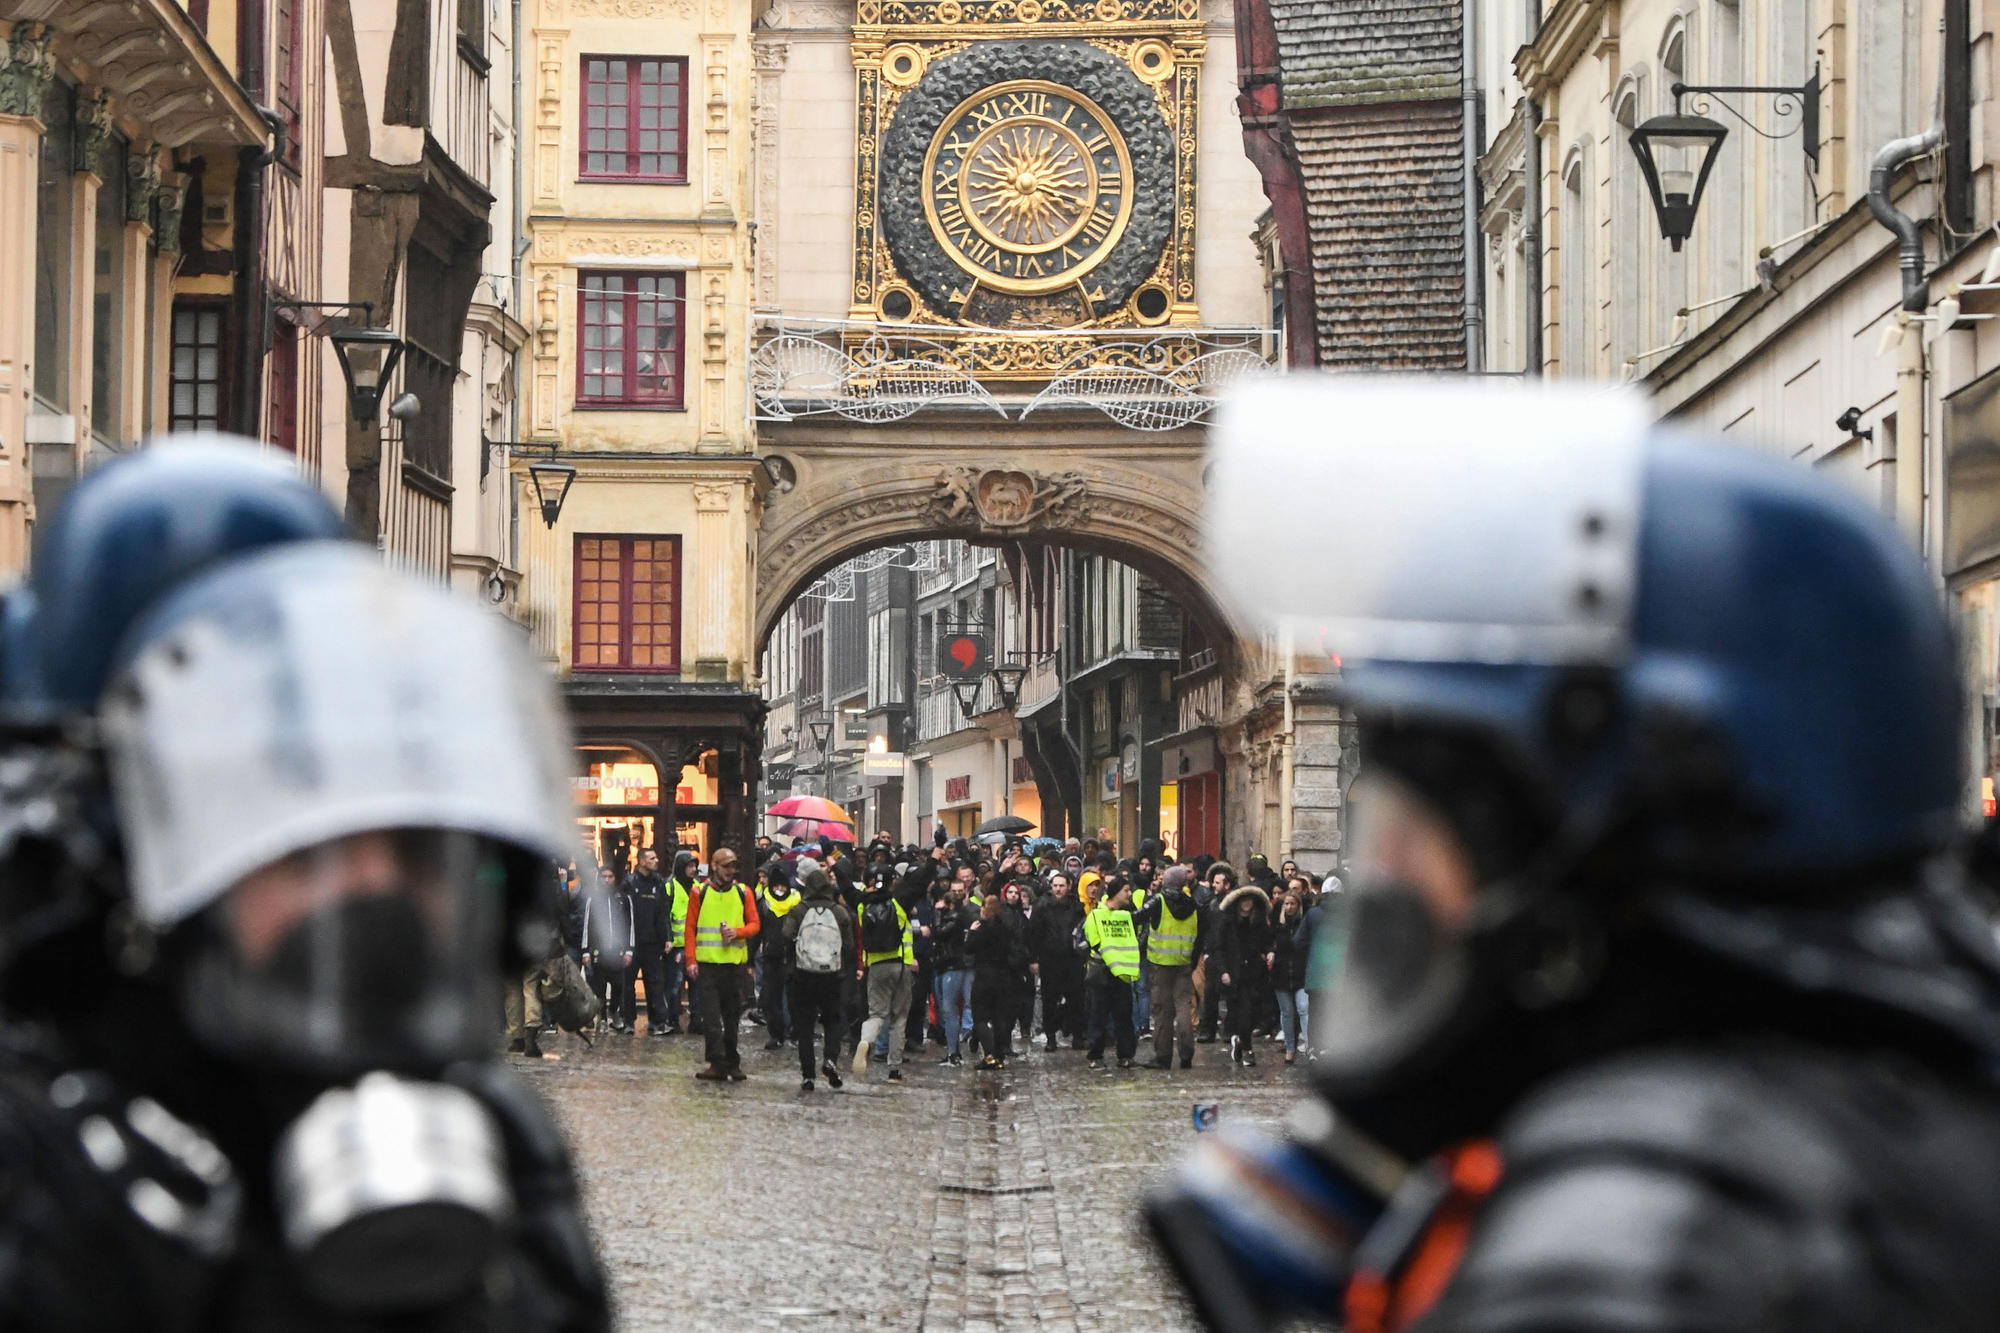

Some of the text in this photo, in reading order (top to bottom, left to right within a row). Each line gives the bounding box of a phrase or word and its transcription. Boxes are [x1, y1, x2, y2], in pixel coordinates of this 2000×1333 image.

[969, 99, 1002, 131] XI
[1008, 93, 1047, 116] XII
[1061, 104, 1075, 124] I
[944, 131, 971, 160] X
[1085, 132, 1111, 154] II
[936, 170, 959, 200] IX
[1099, 172, 1121, 195] III
[939, 204, 970, 249] VIII
[1083, 210, 1115, 242] IIII
[969, 240, 1001, 271] VII
[1015, 255, 1045, 277] VI
[1063, 245, 1082, 268] V
